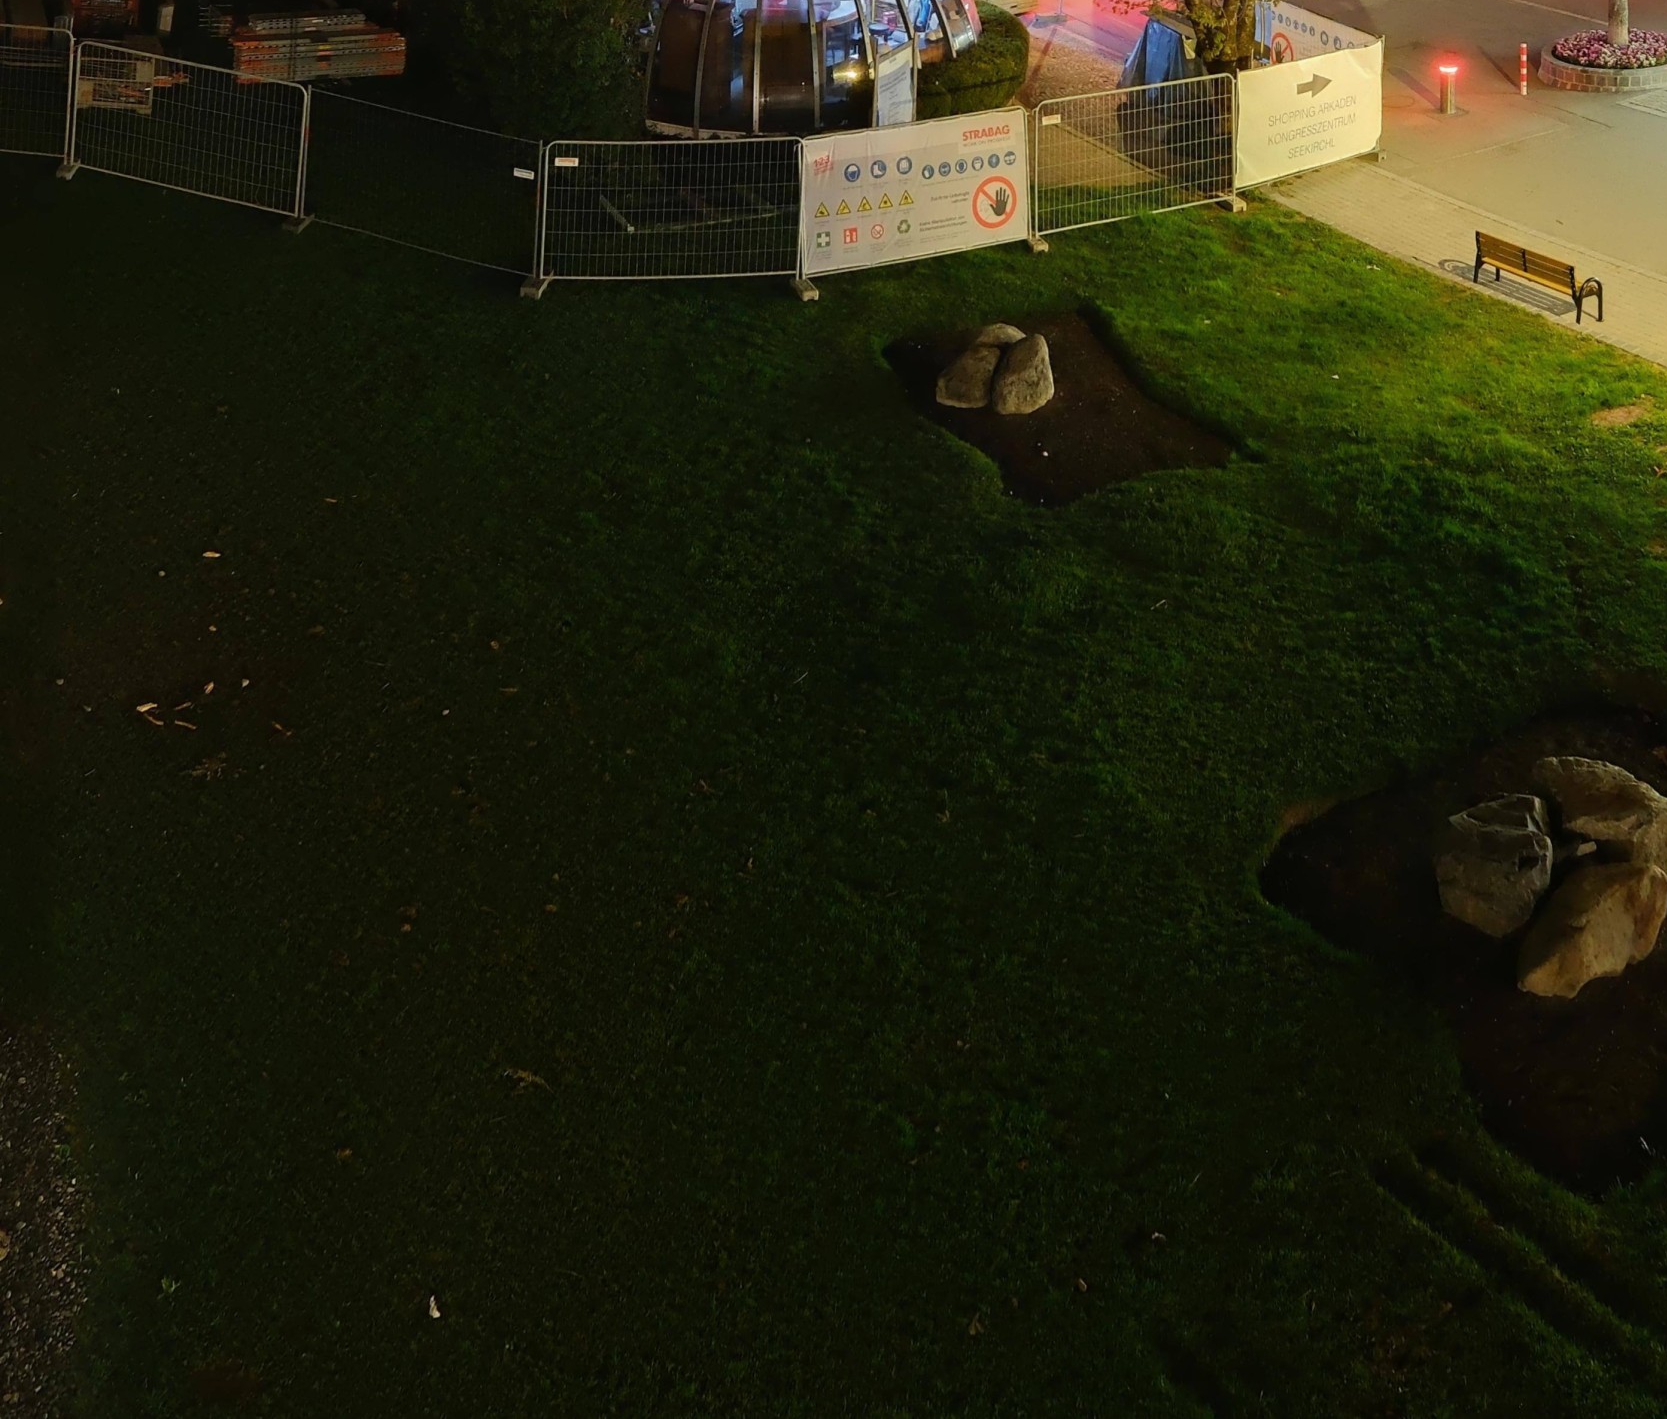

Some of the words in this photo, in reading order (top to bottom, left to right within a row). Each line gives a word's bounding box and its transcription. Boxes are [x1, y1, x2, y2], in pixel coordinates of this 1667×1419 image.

[1268, 106, 1316, 127] SHOPPING
[1318, 95, 1357, 113] ARKADEN
[962, 125, 1010, 141] STRABAG
[1267, 113, 1356, 146] KONGRESSZENTRUM
[1288, 138, 1335, 159] SEEKIRCHL
